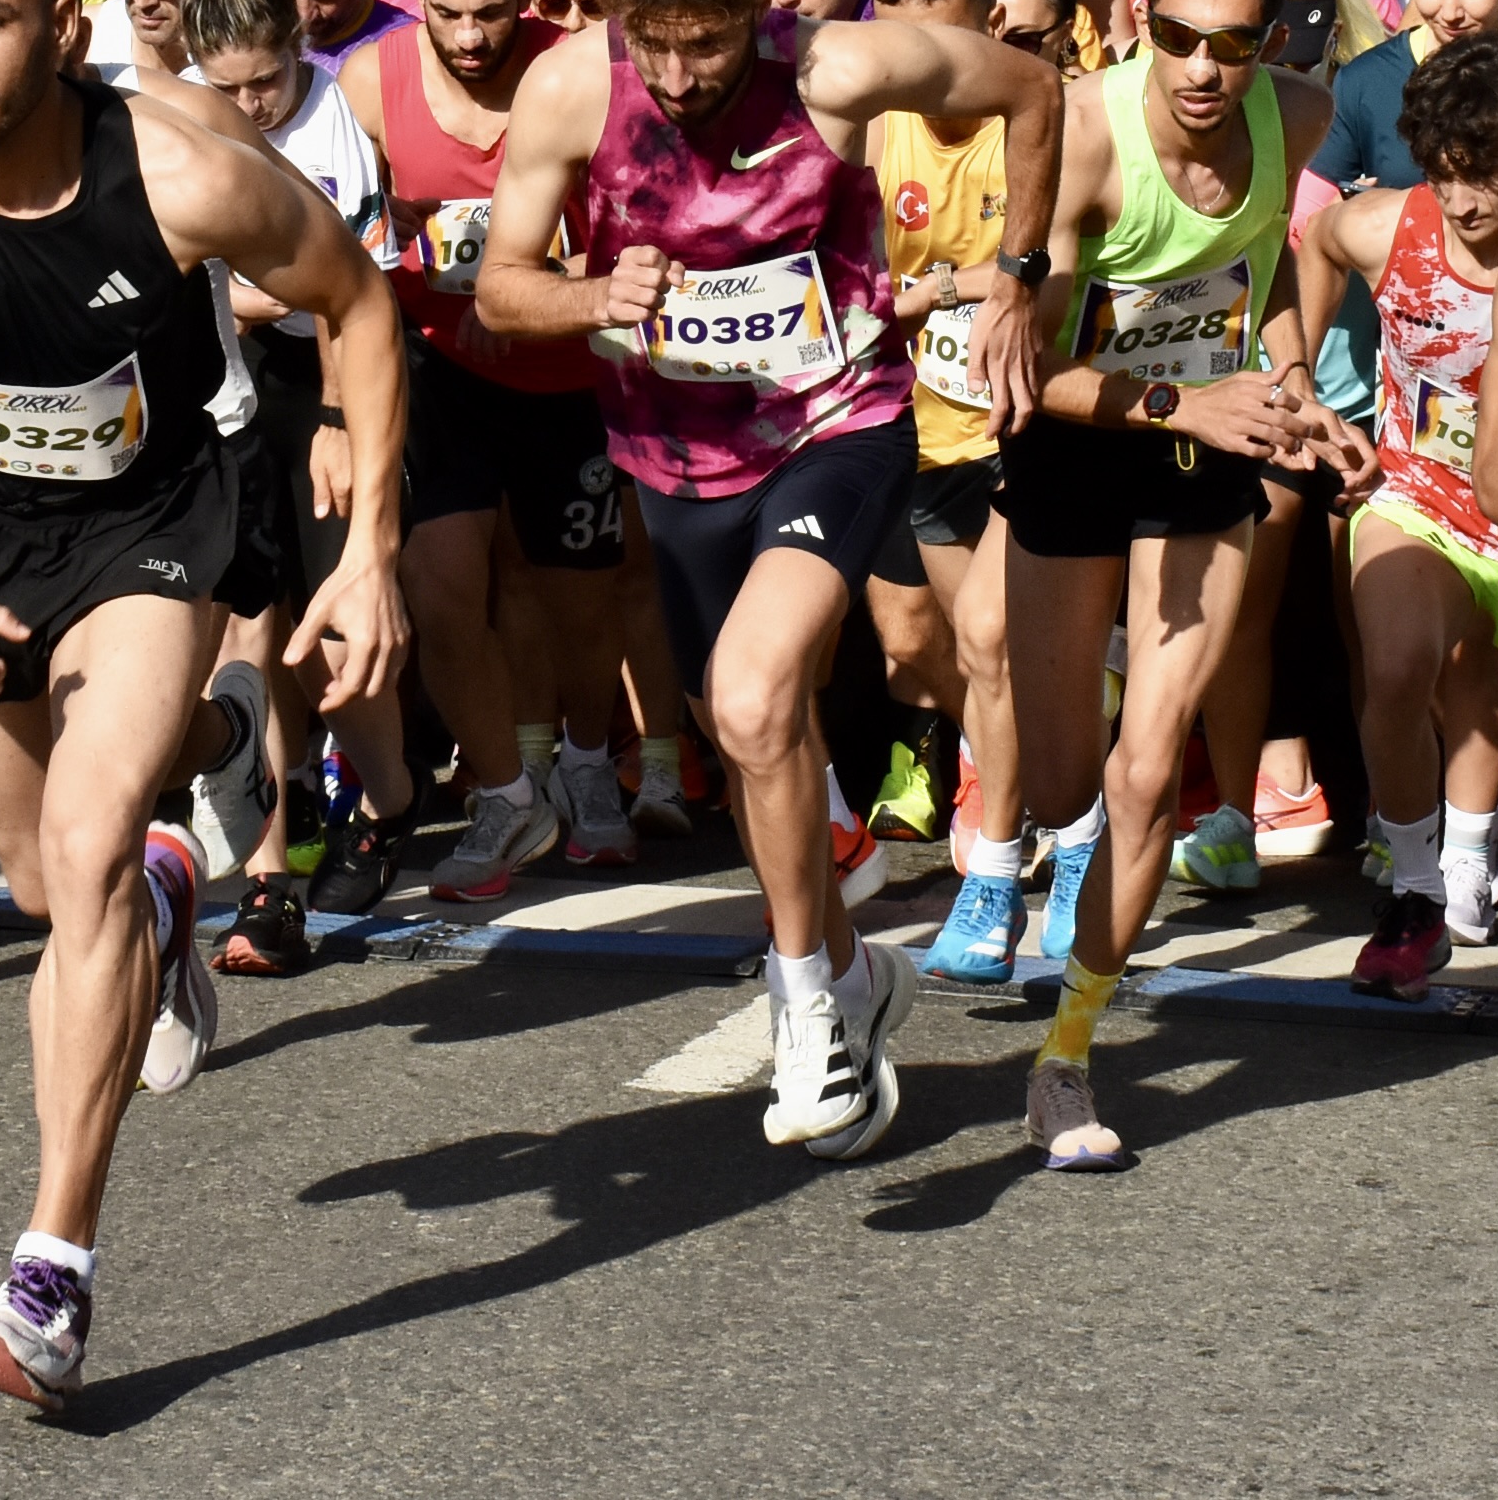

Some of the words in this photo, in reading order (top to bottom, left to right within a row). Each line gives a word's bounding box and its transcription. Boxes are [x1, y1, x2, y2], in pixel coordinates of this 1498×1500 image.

[440, 237, 487, 265] 10
[697, 274, 759, 296] ORDU
[658, 301, 806, 346] 10387
[1098, 308, 1232, 355] 10328
[8, 394, 81, 411] ORDU
[562, 490, 624, 550] 34
